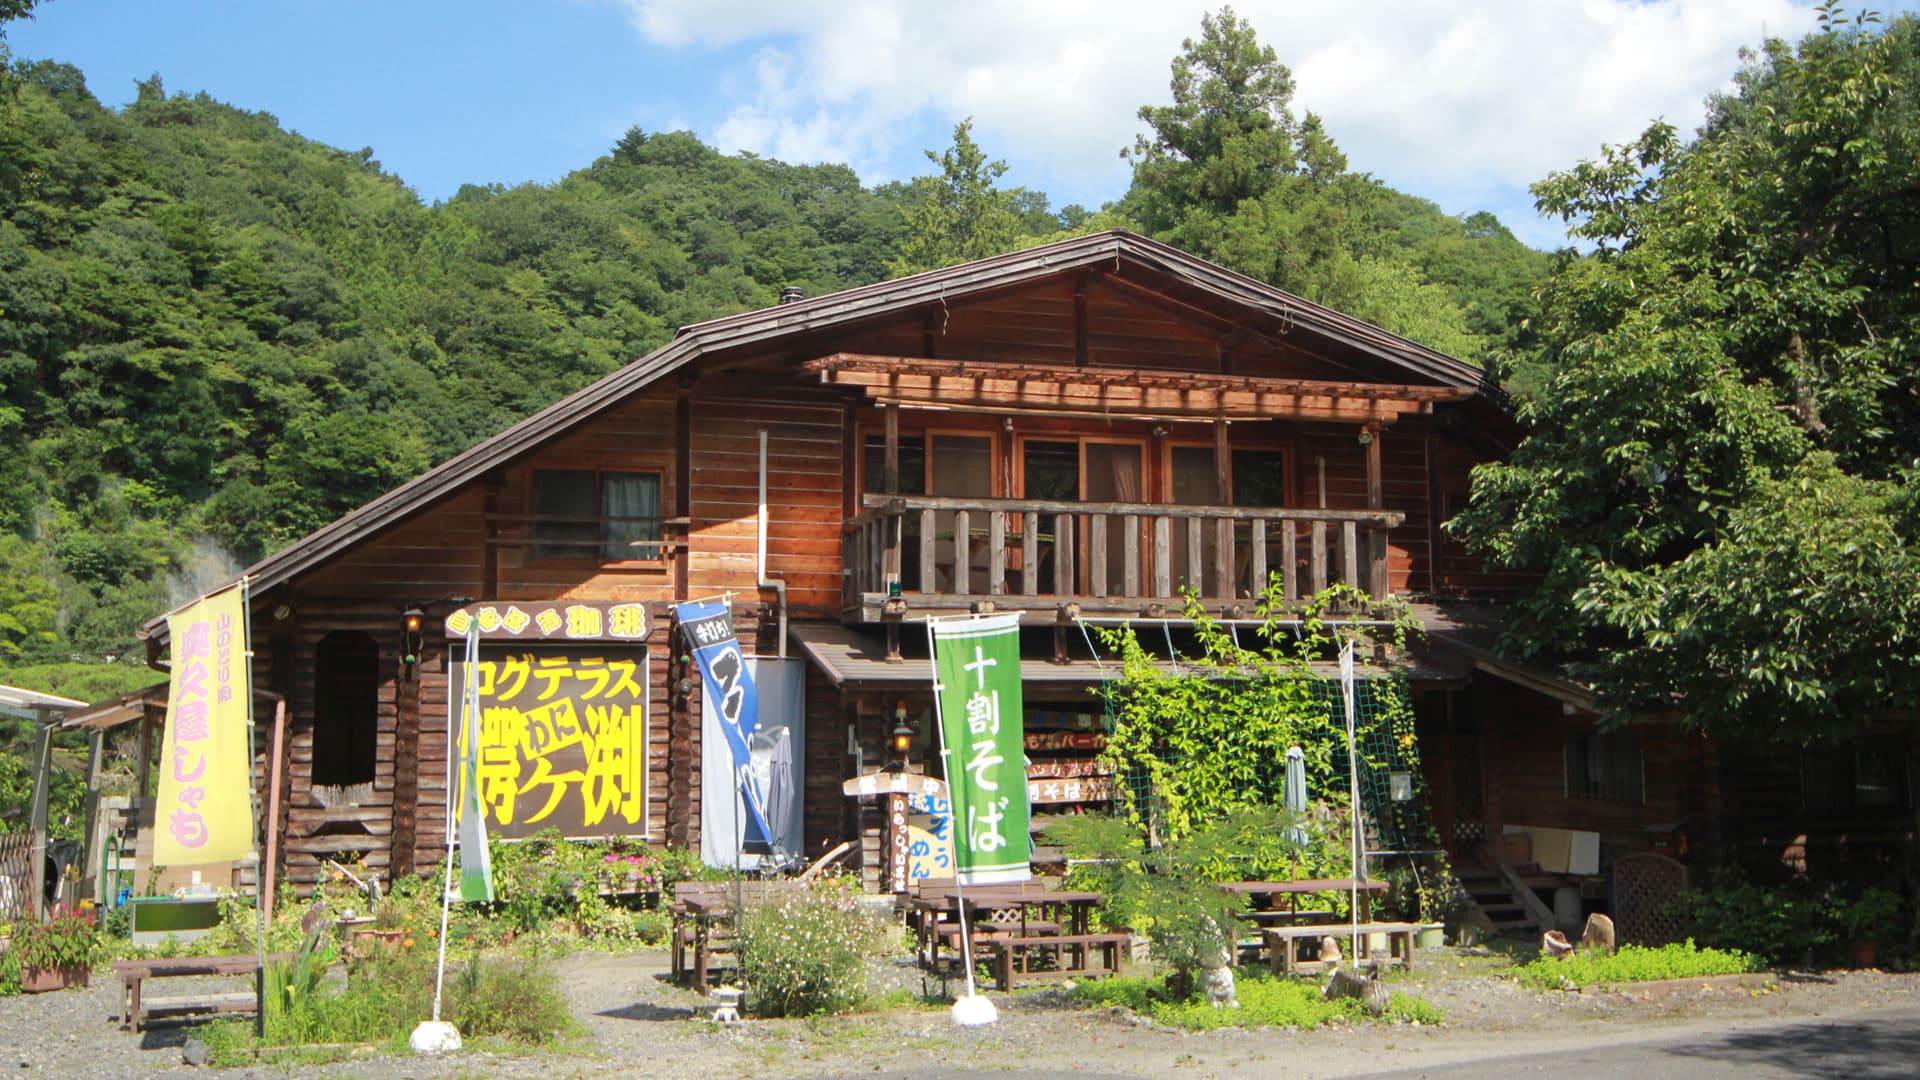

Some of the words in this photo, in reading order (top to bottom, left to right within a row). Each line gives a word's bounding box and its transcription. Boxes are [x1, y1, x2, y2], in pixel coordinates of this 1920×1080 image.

[463, 653, 642, 701] ログテラス
[964, 646, 1010, 853] 十割そば
[893, 799, 909, 893] いらっしゃいませ
